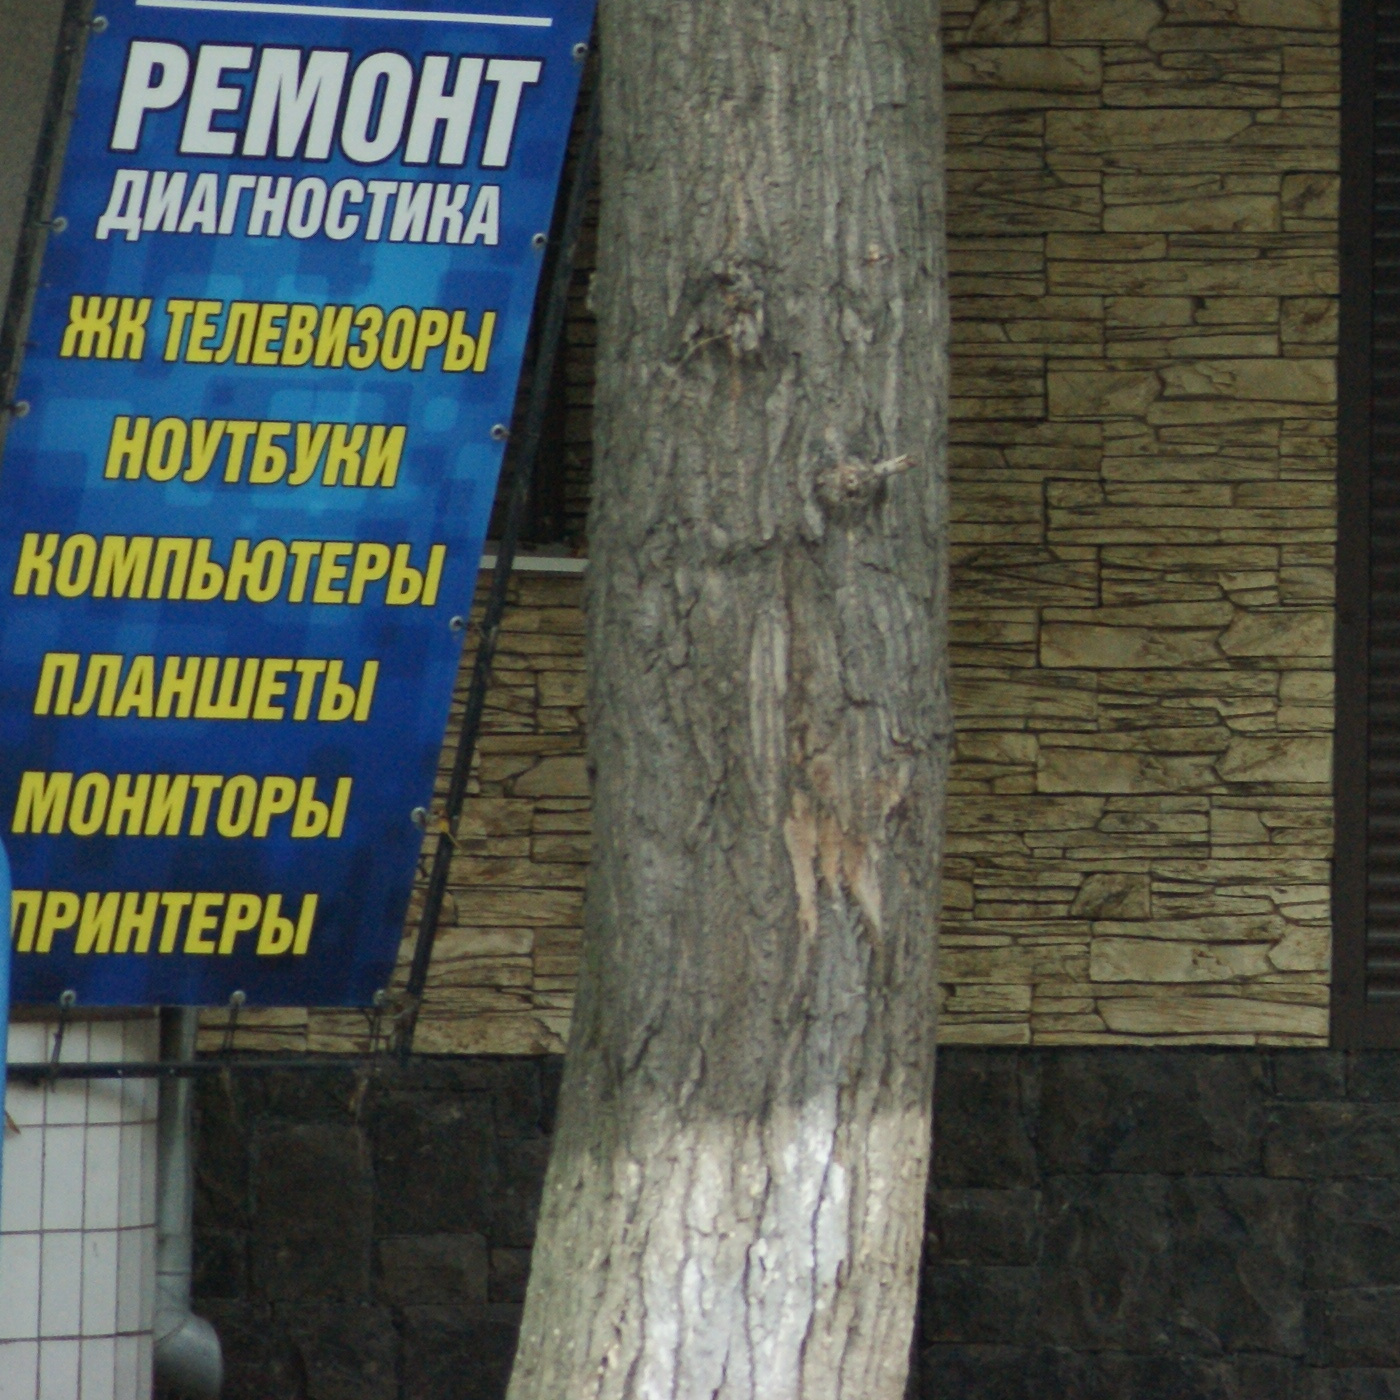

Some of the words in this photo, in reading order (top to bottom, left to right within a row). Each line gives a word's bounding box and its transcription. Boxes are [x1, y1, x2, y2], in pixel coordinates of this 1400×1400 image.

[111, 41, 542, 167] РЕМОНТ
[96, 169, 500, 245] ДИАГНОСТИКА
[61, 295, 151, 360] ЖК
[164, 299, 496, 372] ТЕЛЕВИЗОРЫ
[105, 416, 406, 487] НОУТБУКИ
[13, 532, 446, 606] КОМПЬЮТЕРЫ
[34, 653, 379, 721] ПЛАНШЕТЫ
[12, 771, 352, 838] МОНИТОРЫ
[12, 890, 318, 955] ПРИНТЕРЫ
